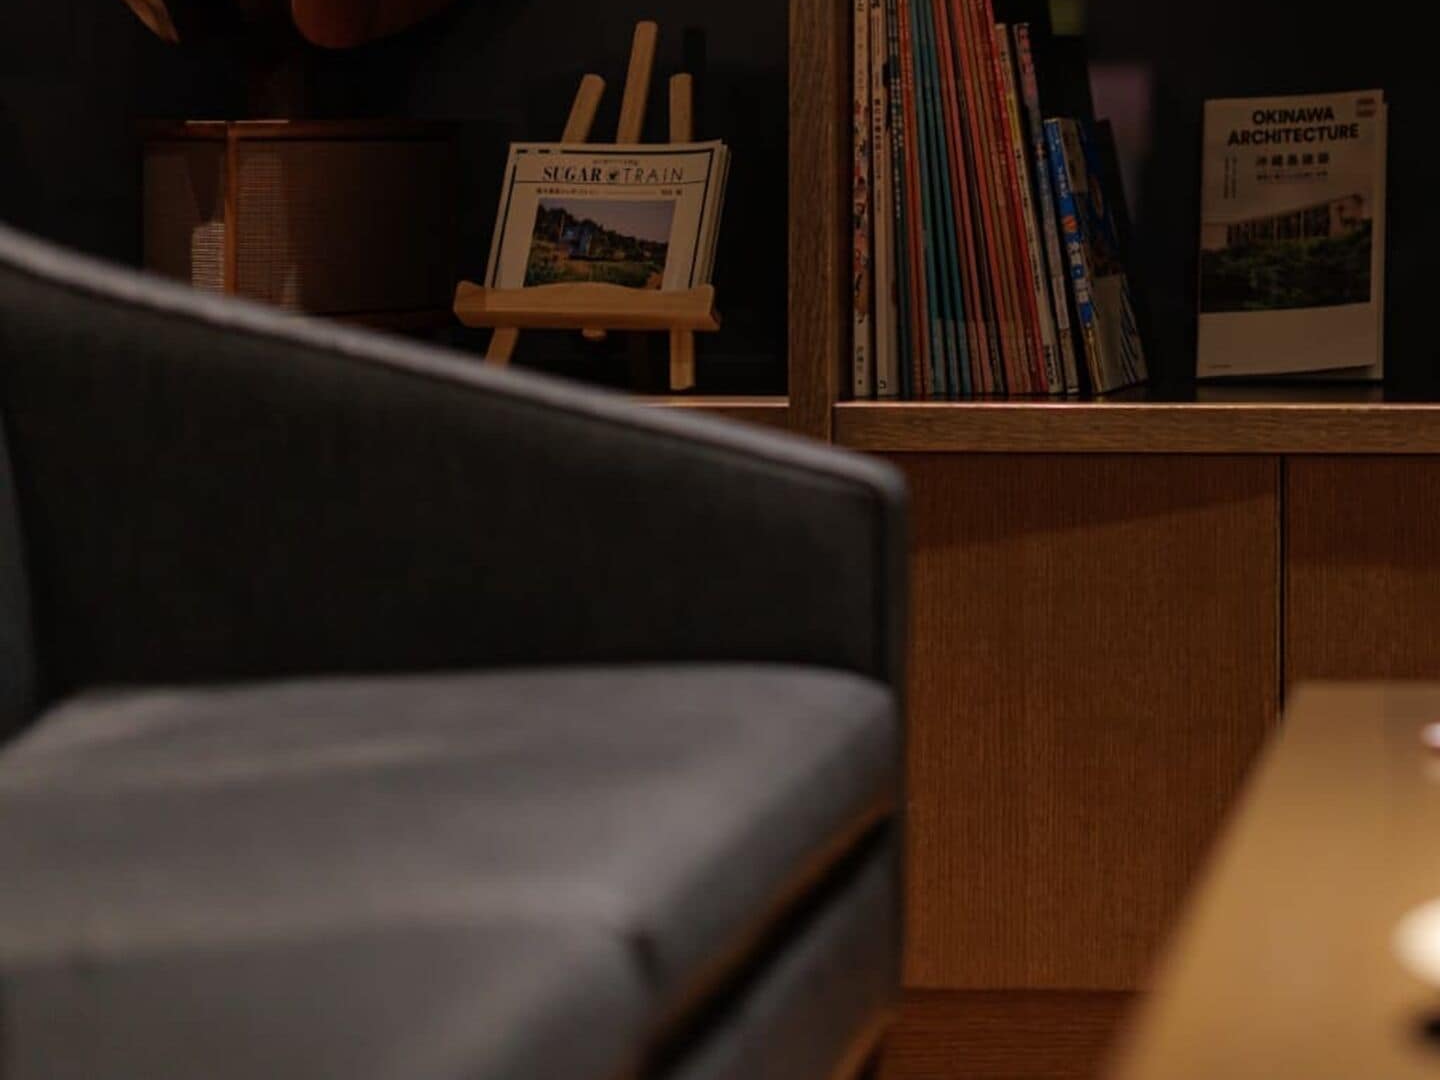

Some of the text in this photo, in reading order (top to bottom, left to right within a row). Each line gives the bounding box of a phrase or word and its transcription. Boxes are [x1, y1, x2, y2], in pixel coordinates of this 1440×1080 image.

[1252, 107, 1334, 126] OKINAWA
[1228, 123, 1359, 147] ARCHITECTURE
[543, 166, 683, 182] SUGAR TRAIN
